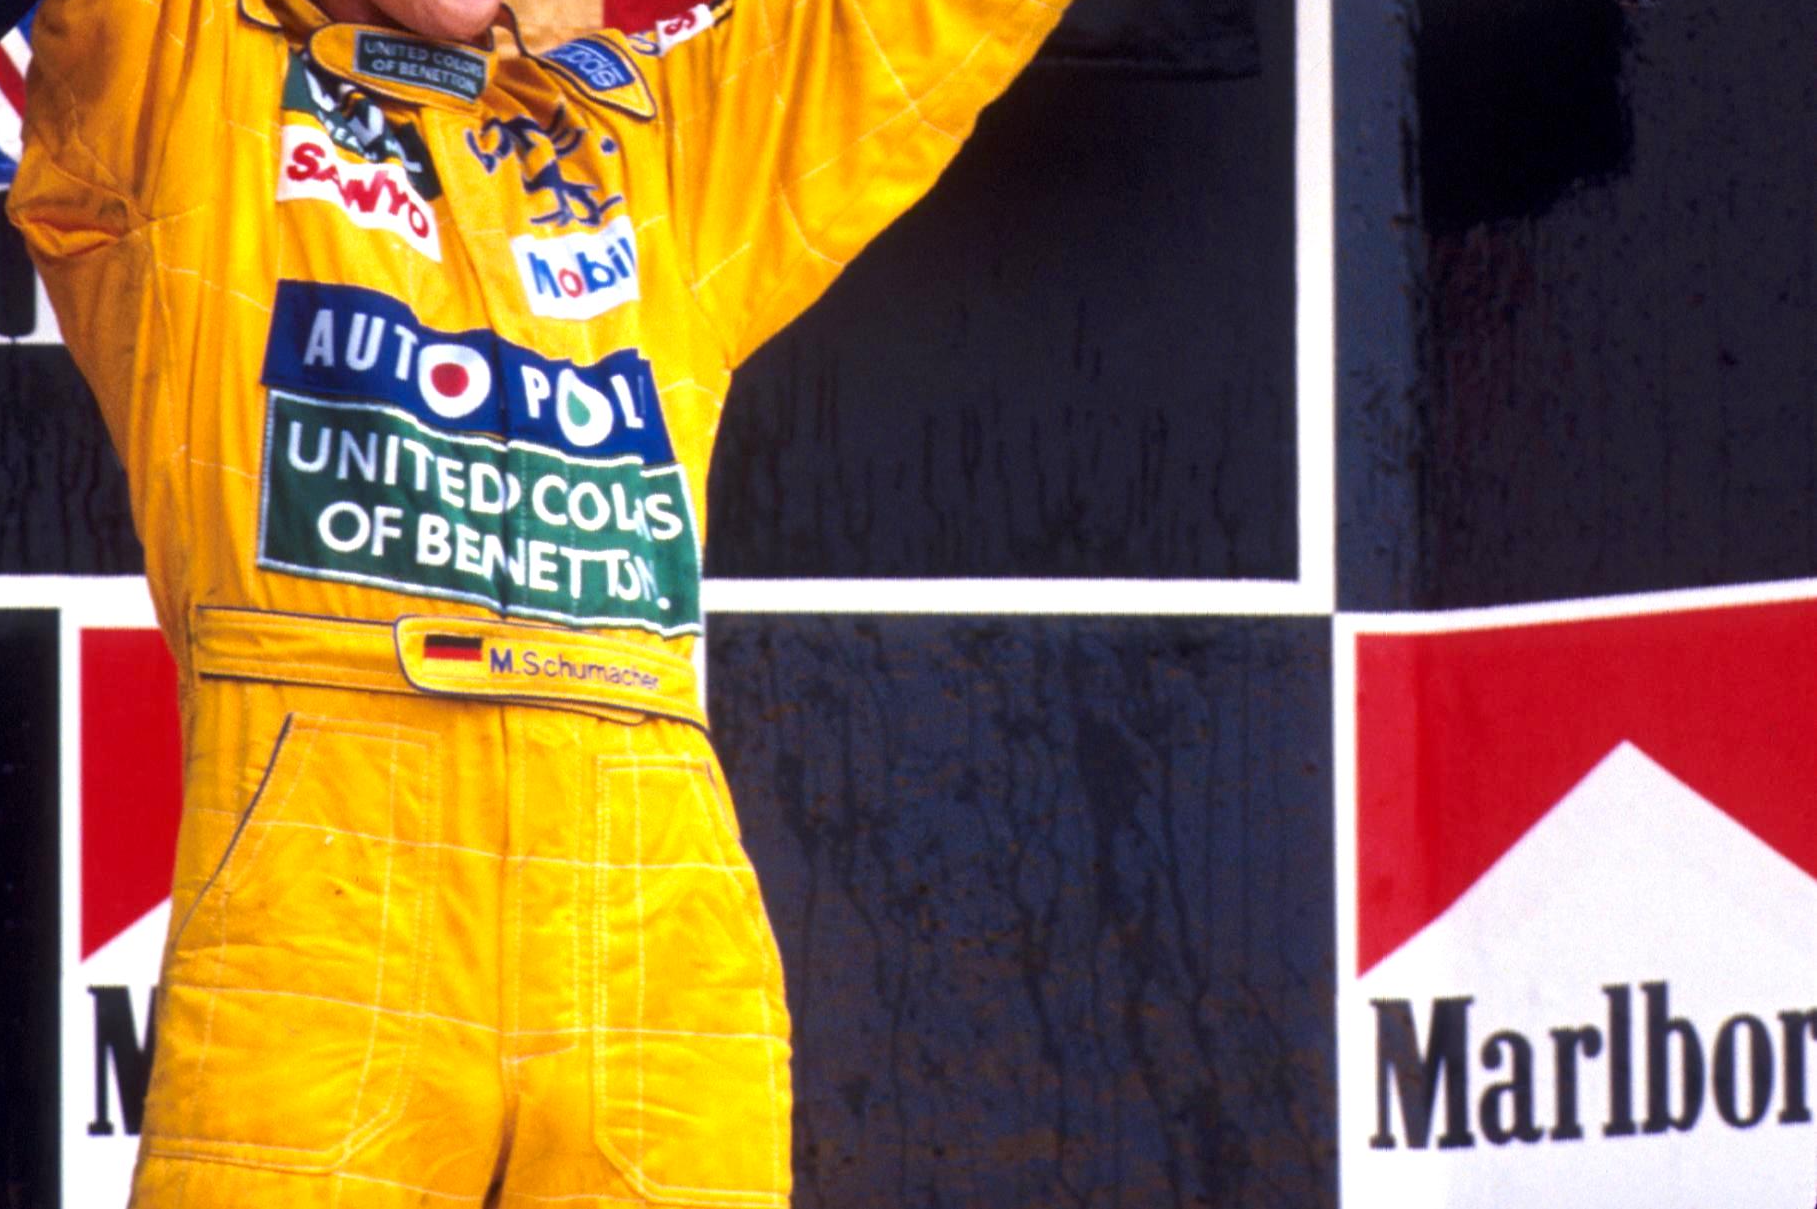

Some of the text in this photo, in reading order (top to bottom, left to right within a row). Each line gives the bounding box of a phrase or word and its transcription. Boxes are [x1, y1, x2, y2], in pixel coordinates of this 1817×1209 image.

[286, 141, 432, 239] SANYO
[288, 421, 522, 515] UNITED
[317, 500, 403, 556] OF
